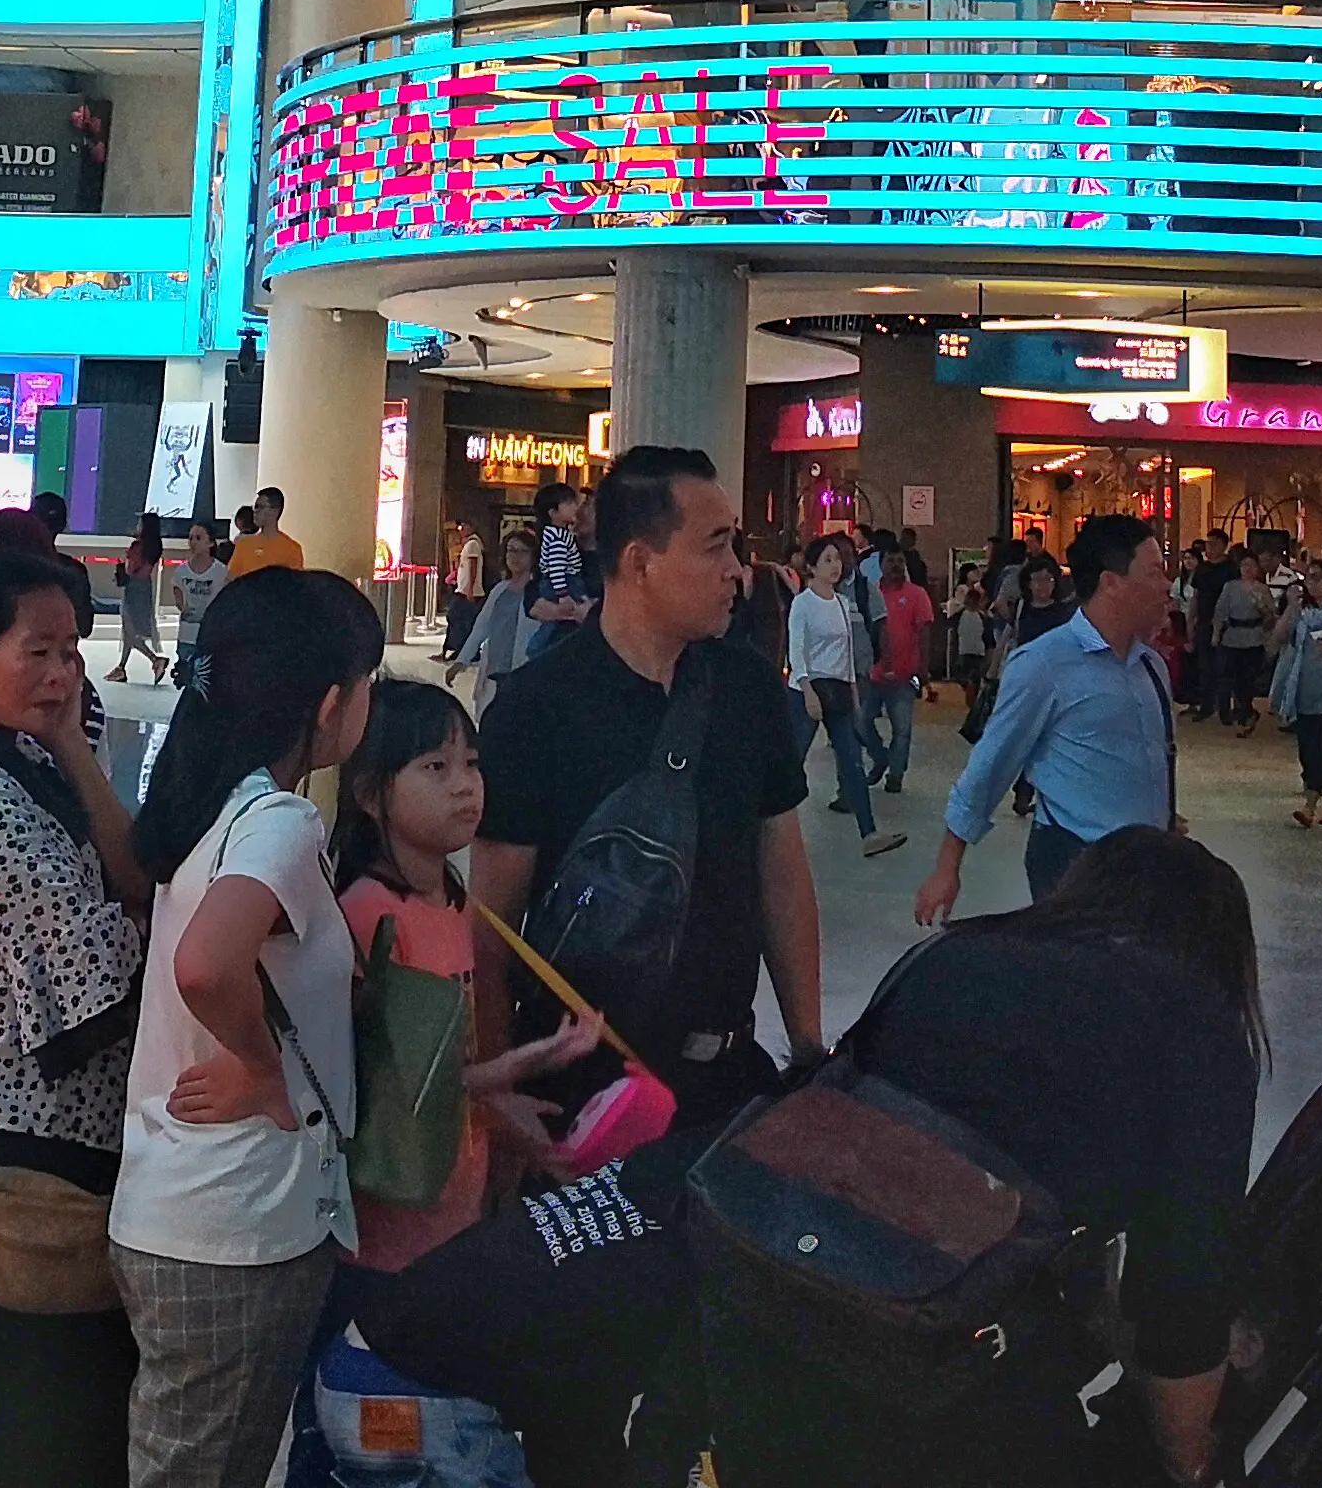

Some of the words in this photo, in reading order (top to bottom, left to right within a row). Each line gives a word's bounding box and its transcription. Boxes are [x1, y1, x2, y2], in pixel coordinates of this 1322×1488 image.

[544, 65, 831, 215] SALE
[489, 437, 527, 462] NAM
[529, 440, 587, 467] HEONG
[577, 1205, 605, 1247] zipper
[591, 1189, 613, 1209] and
[602, 1210, 625, 1241] may
[626, 1211, 644, 1237] the
[569, 1235, 585, 1253] to
